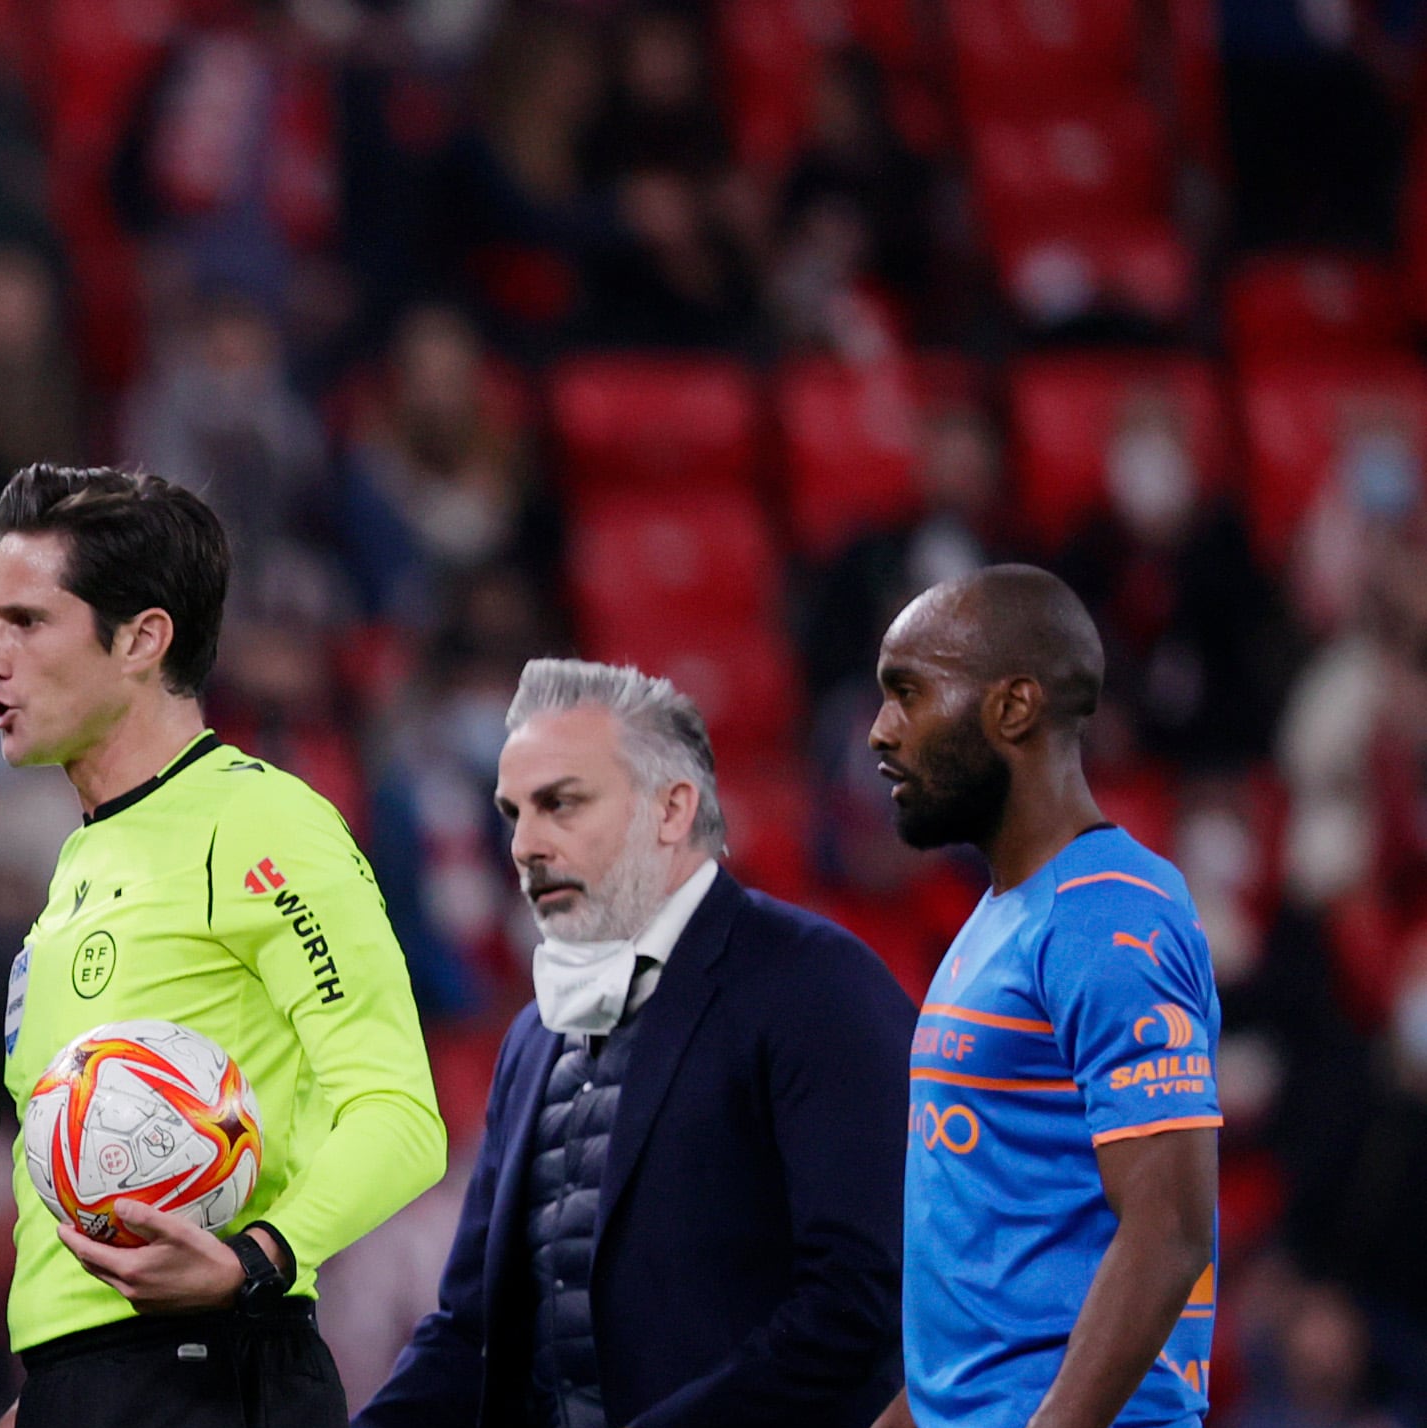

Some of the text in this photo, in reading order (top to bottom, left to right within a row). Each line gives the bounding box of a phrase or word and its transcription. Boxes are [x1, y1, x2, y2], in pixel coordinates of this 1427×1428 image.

[274, 890, 344, 1004] WÜRTH
[942, 1030, 975, 1061] CF
[1144, 1080, 1204, 1098] TYRE
